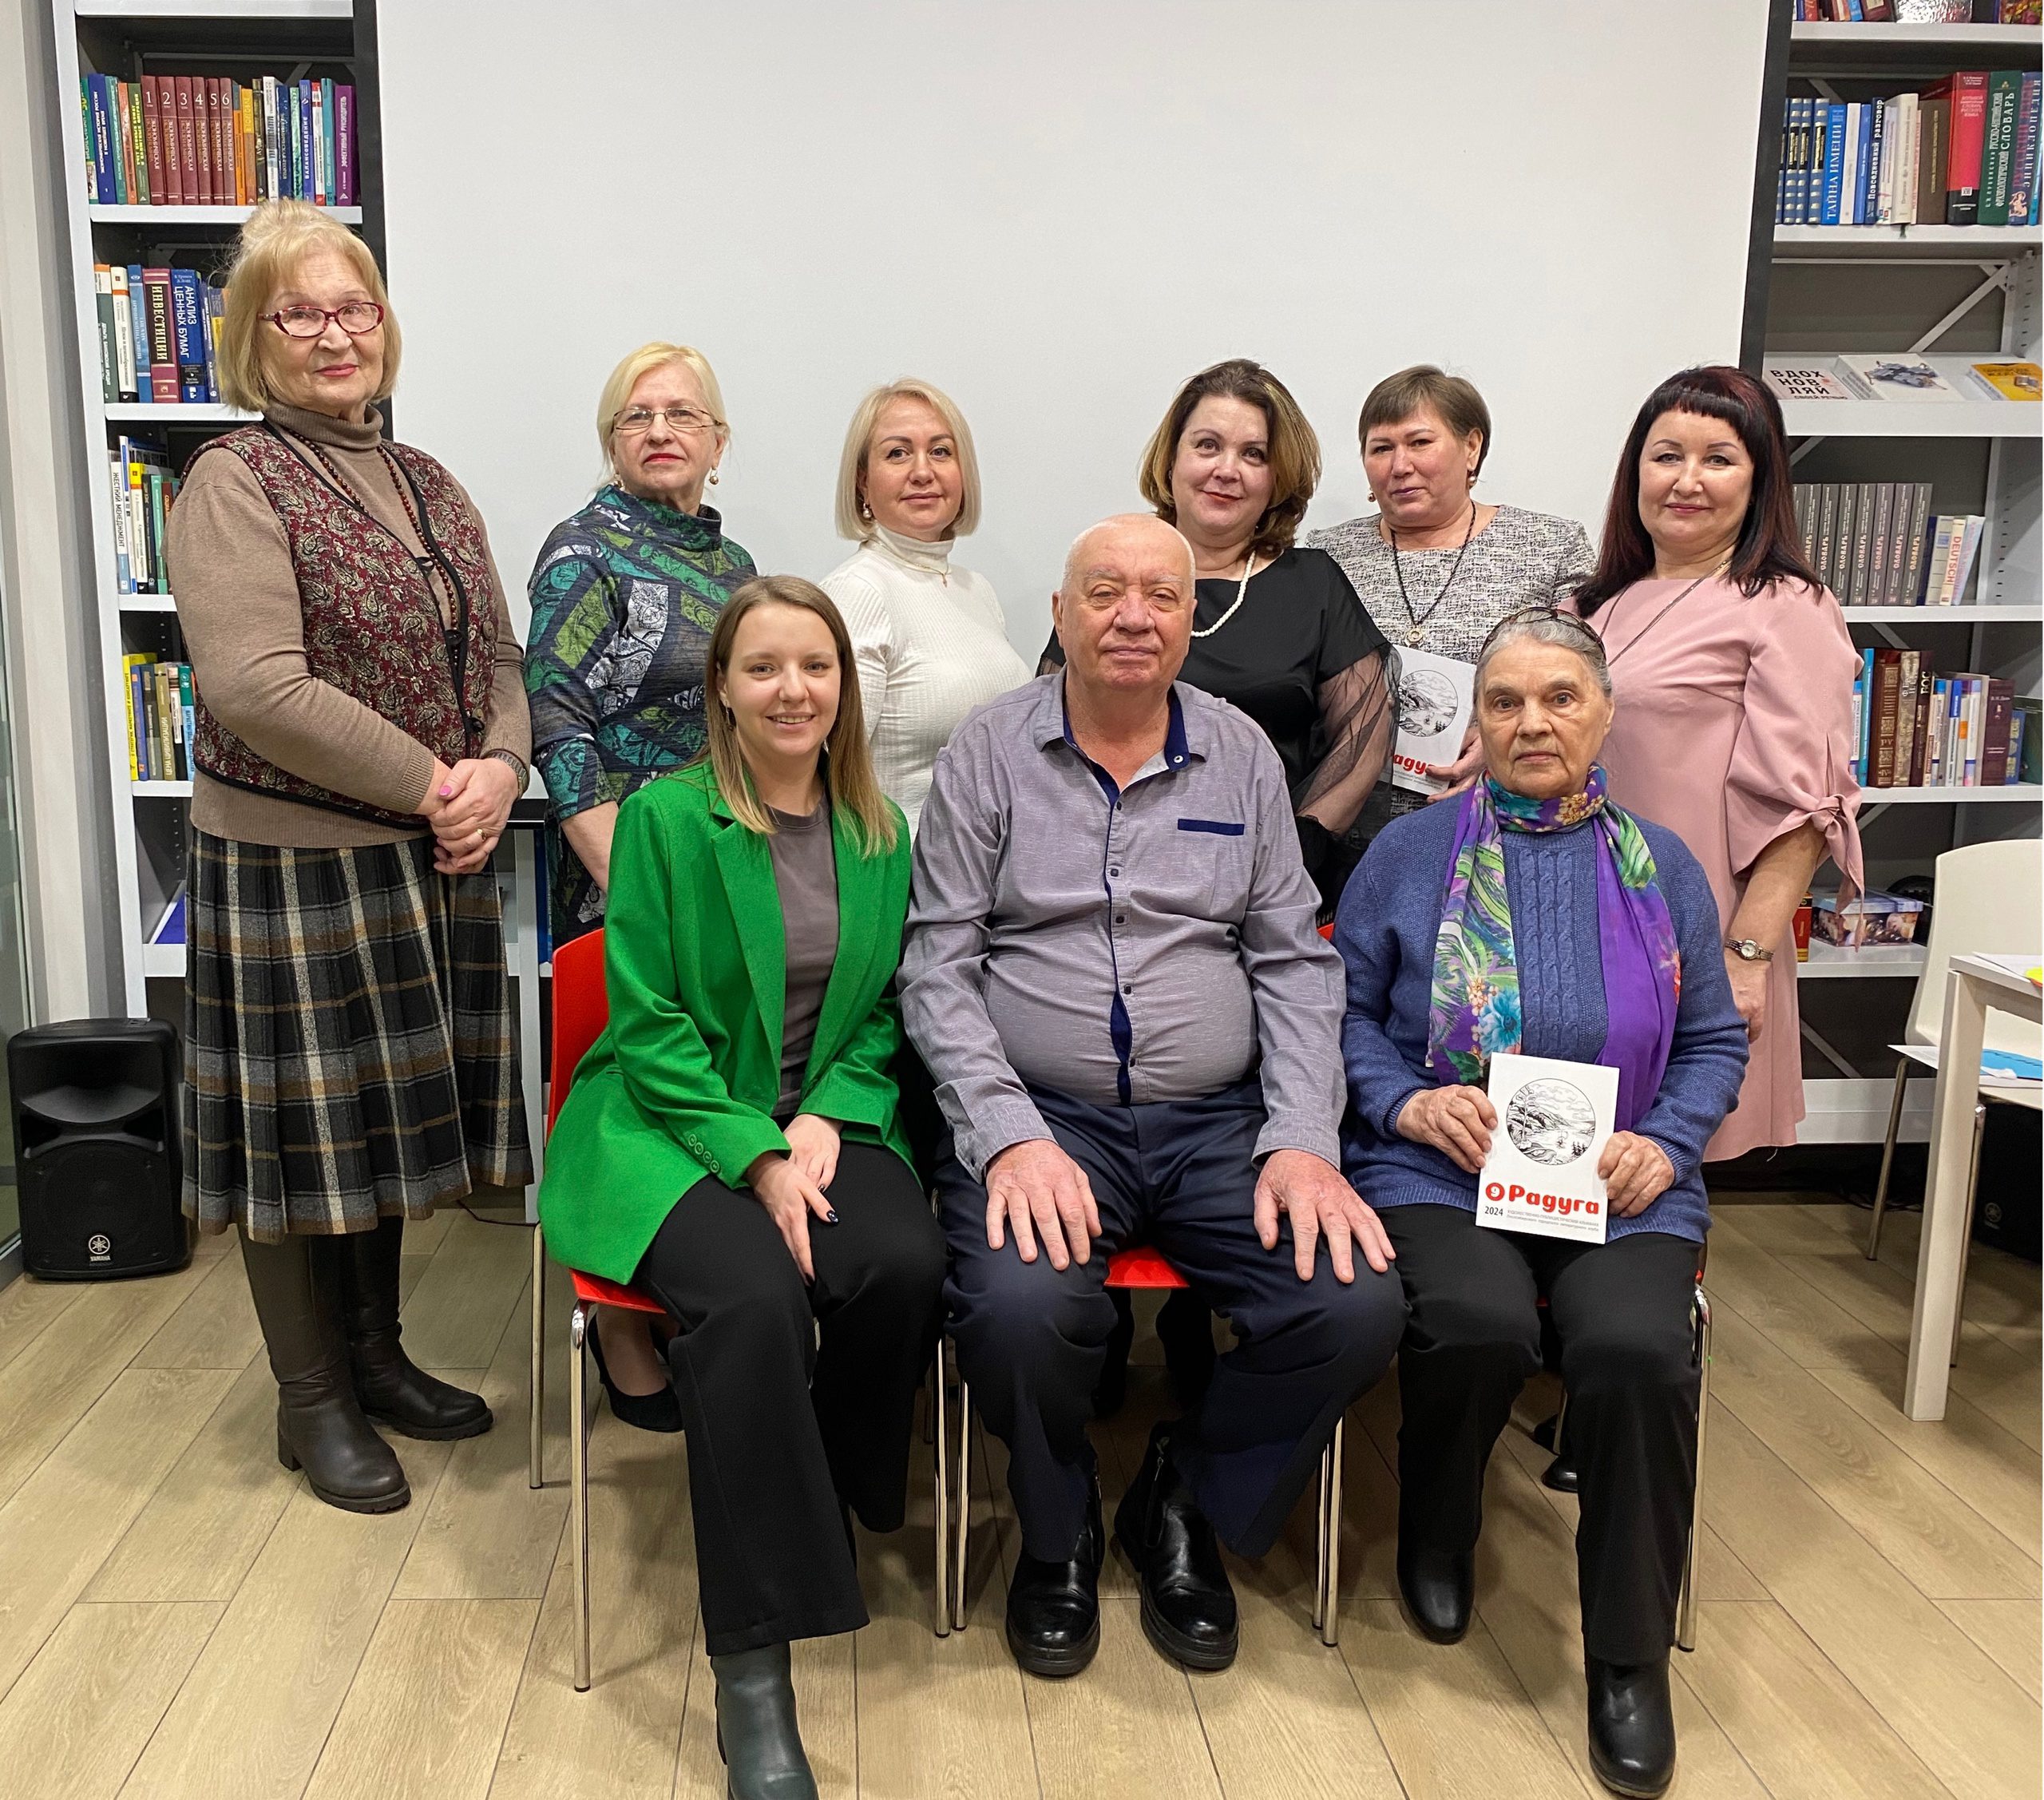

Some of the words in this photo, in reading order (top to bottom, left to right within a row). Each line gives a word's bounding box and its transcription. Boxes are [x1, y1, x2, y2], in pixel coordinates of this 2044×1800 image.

[146, 91, 152, 104] 1
[162, 92, 171, 105] 2
[180, 93, 188, 105] 3
[195, 93, 204, 105] 4
[210, 93, 217, 105] 5
[222, 93, 230, 105] 6
[1873, 99, 1884, 138] разговор
[2002, 92, 2014, 150] СЛОВАРЬ
[2023, 79, 2042, 188] ЭНЦИКЛОПЕДИЯ
[1829, 124, 1843, 172] ИМЕНИ
[1868, 142, 1880, 200] Повседневный
[1826, 176, 1839, 220] ТАЙНА
[173, 286, 186, 326] ЦЕННЫХ
[184, 285, 197, 325] АНАЛИЗ
[152, 285, 168, 361] ИНВЕСТИЦИИ
[178, 328, 189, 359] БУМАГ
[1770, 370, 1825, 379] ВДОХ
[113, 472, 123, 502] ЖЕСТКИЙ
[115, 504, 125, 547] МЕНЕДЖМЕНТ
[1947, 536, 1962, 583] DEUTSCH
[1393, 754, 1436, 775] аду
[1484, 1206, 1503, 1216] 2024
[1508, 1184, 1599, 1215] Радуга
